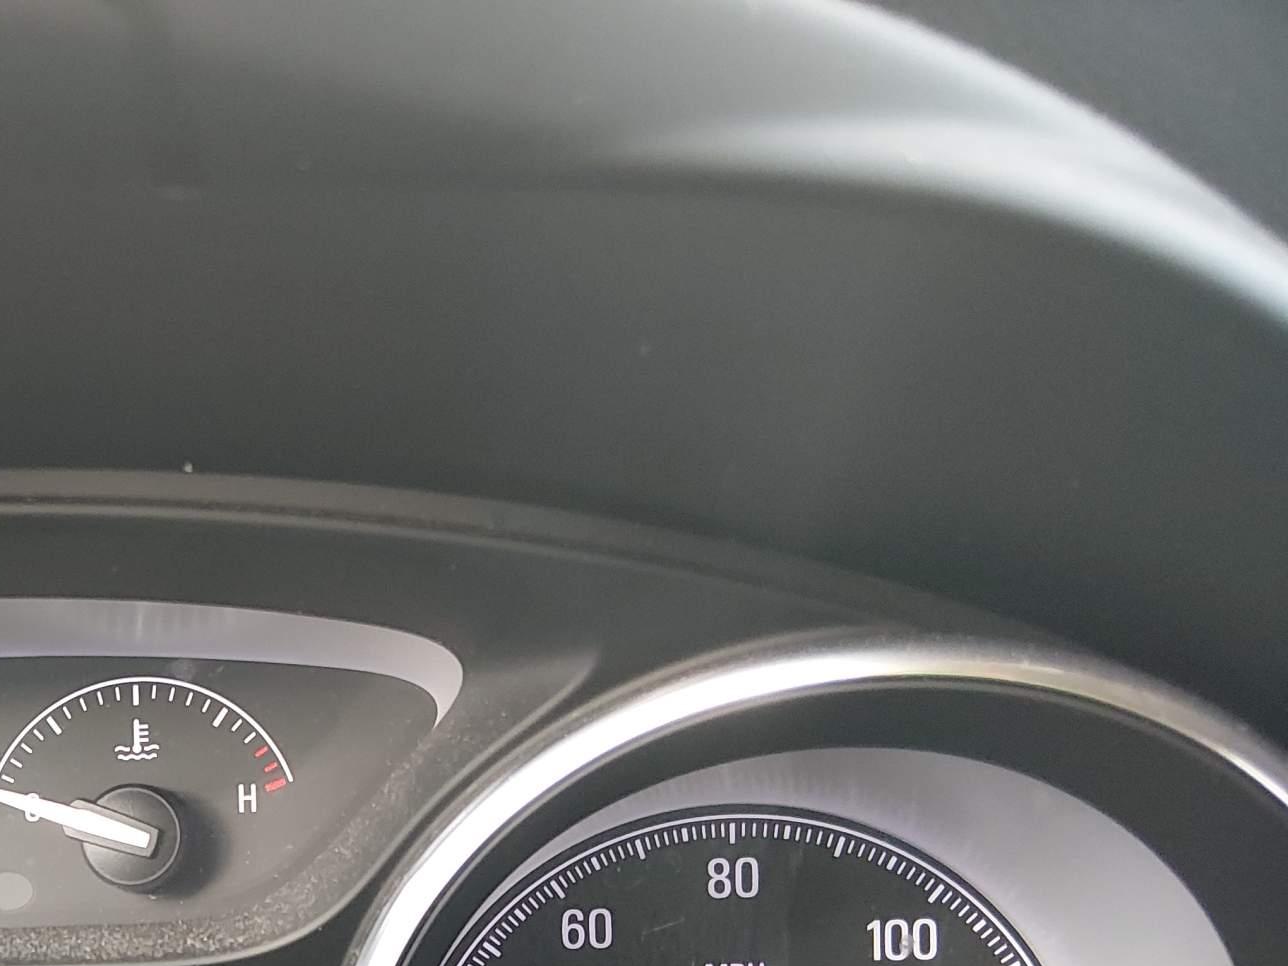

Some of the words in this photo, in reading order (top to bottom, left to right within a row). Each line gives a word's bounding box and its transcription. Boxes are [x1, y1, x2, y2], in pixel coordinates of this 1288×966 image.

[239, 783, 256, 814] H
[707, 856, 759, 899] 80
[561, 908, 613, 950] 60
[866, 918, 938, 962] 100
